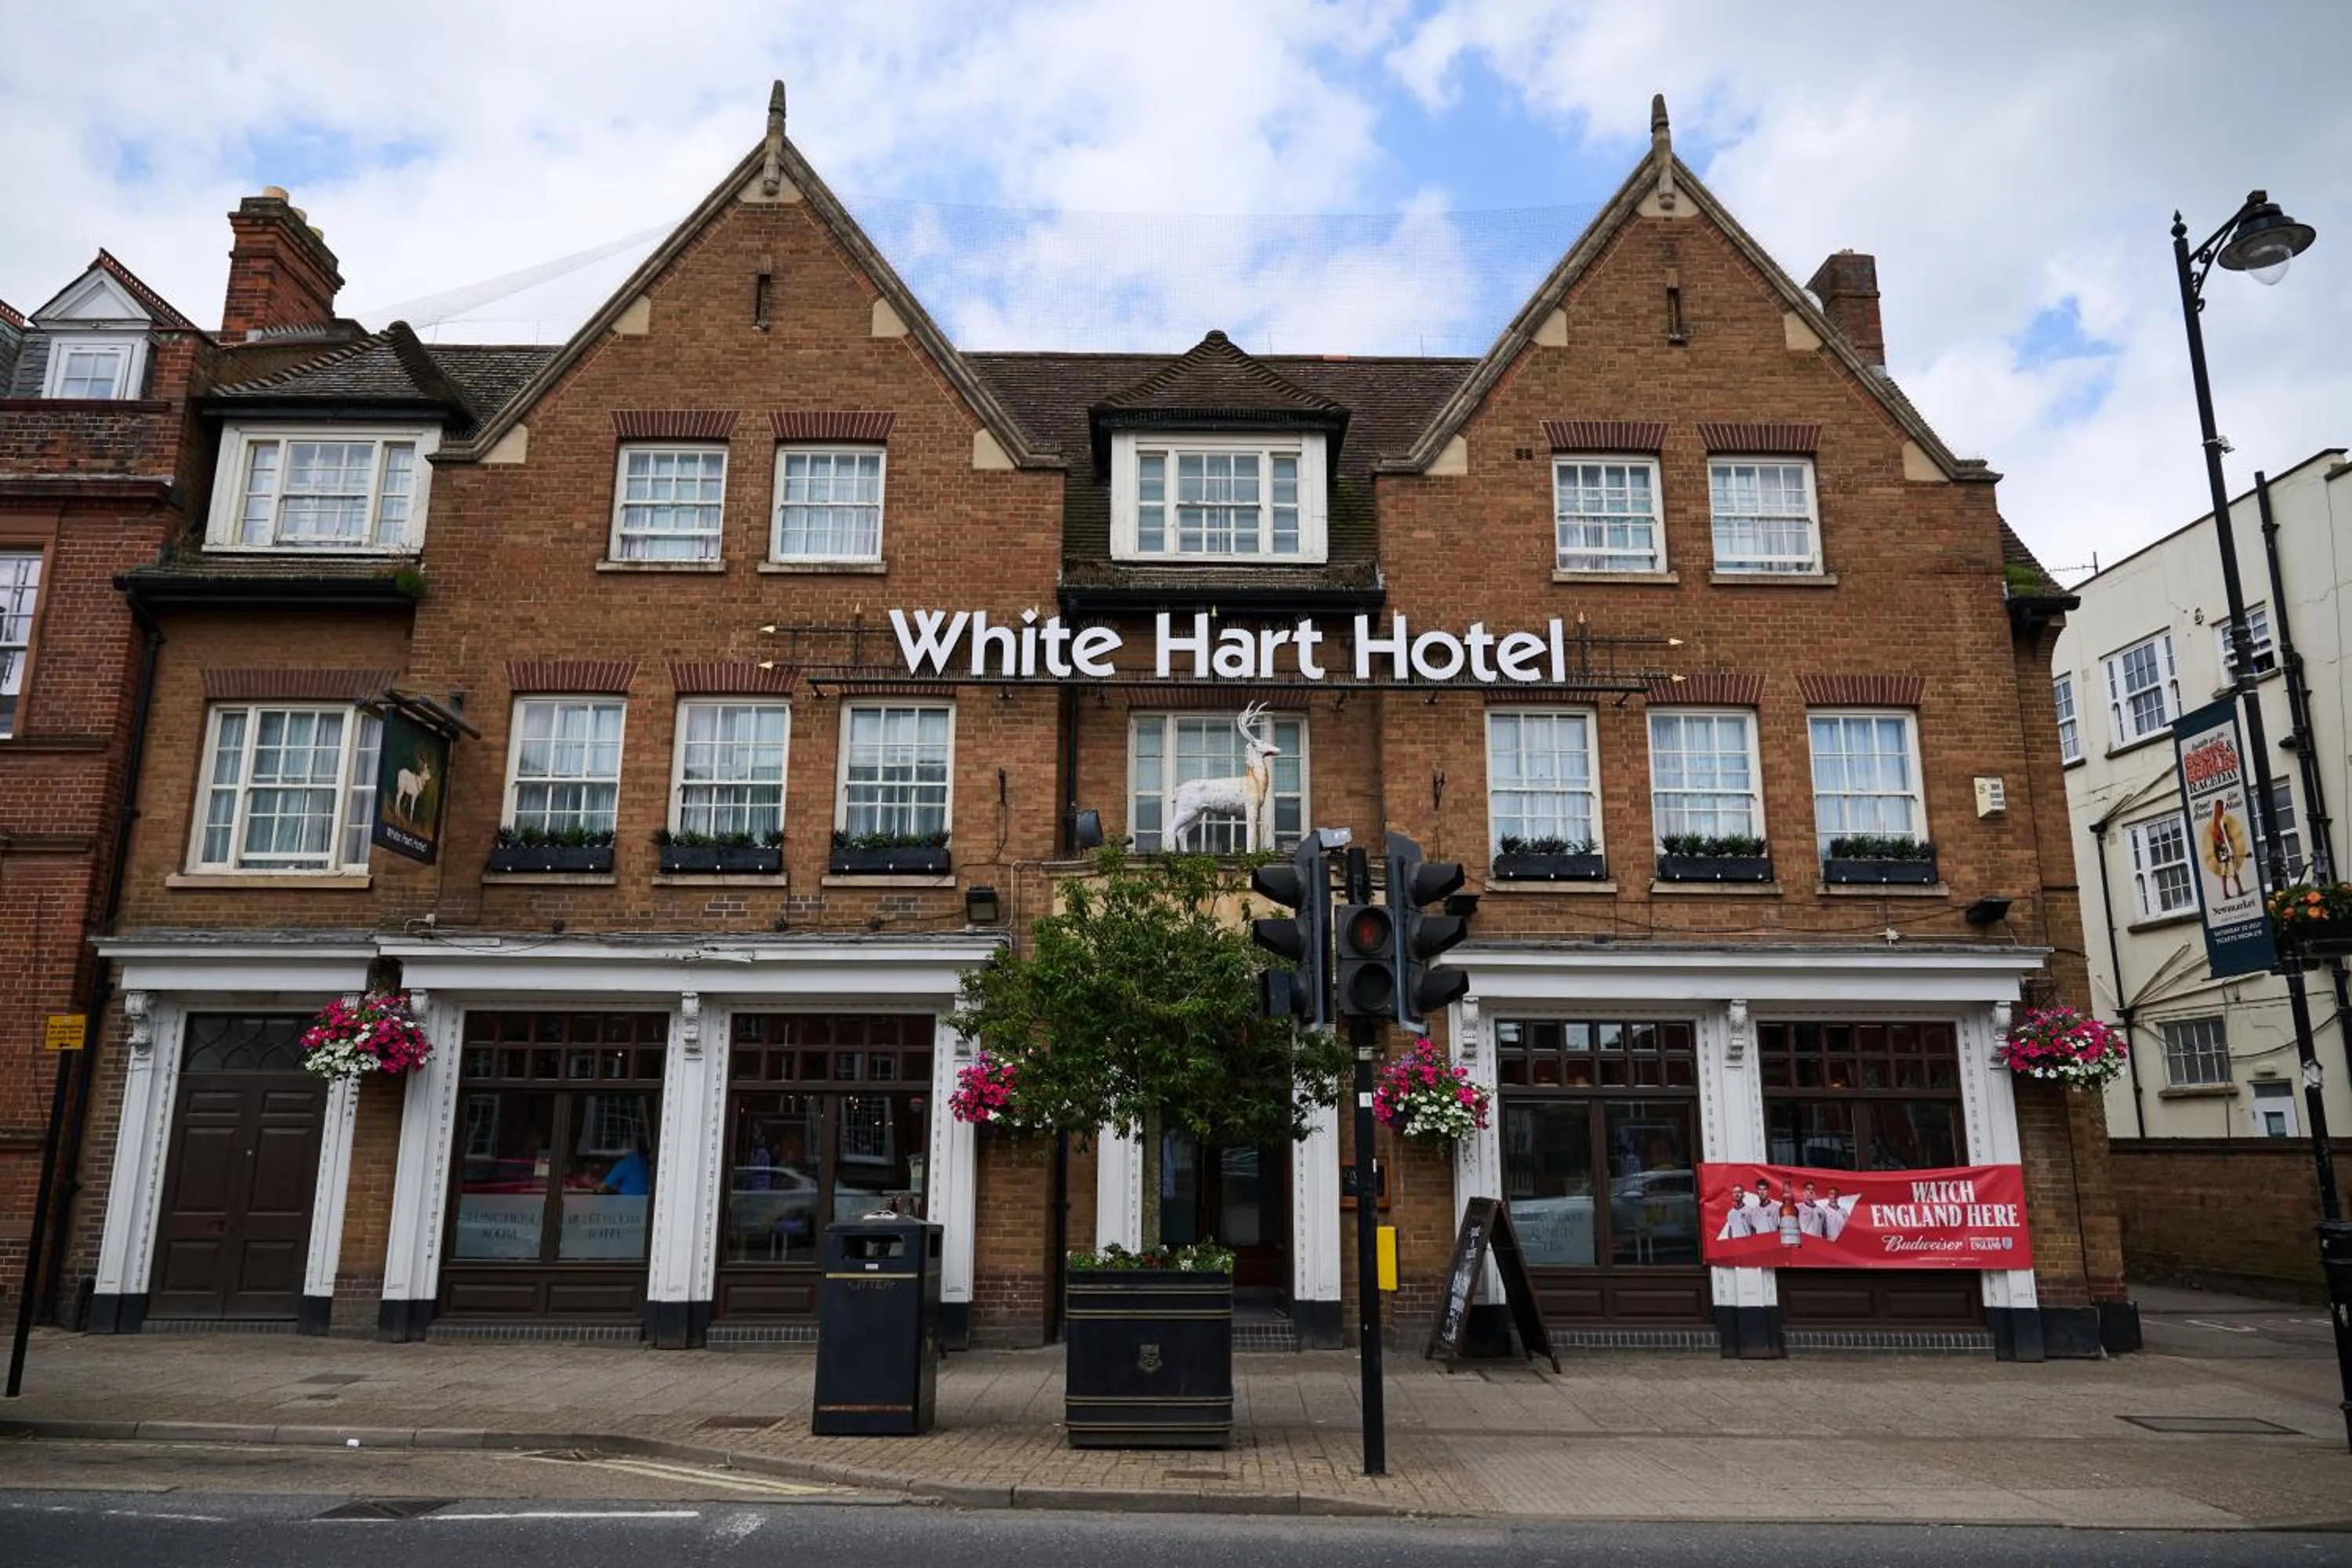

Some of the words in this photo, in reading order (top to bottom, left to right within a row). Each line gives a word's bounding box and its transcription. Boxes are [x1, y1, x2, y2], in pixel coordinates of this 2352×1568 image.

[888, 609, 1123, 677] White
[1156, 612, 1325, 680] Hart
[1354, 614, 1566, 682] Hotel
[2189, 768, 2238, 793] RACEDAY
[2212, 898, 2256, 915] Newmarket
[1911, 1180, 1976, 1203] WATCH
[1871, 1203, 1962, 1228] ENGLAND
[1967, 1203, 2020, 1228] HERE
[1882, 1236, 1963, 1252] Budweiser
